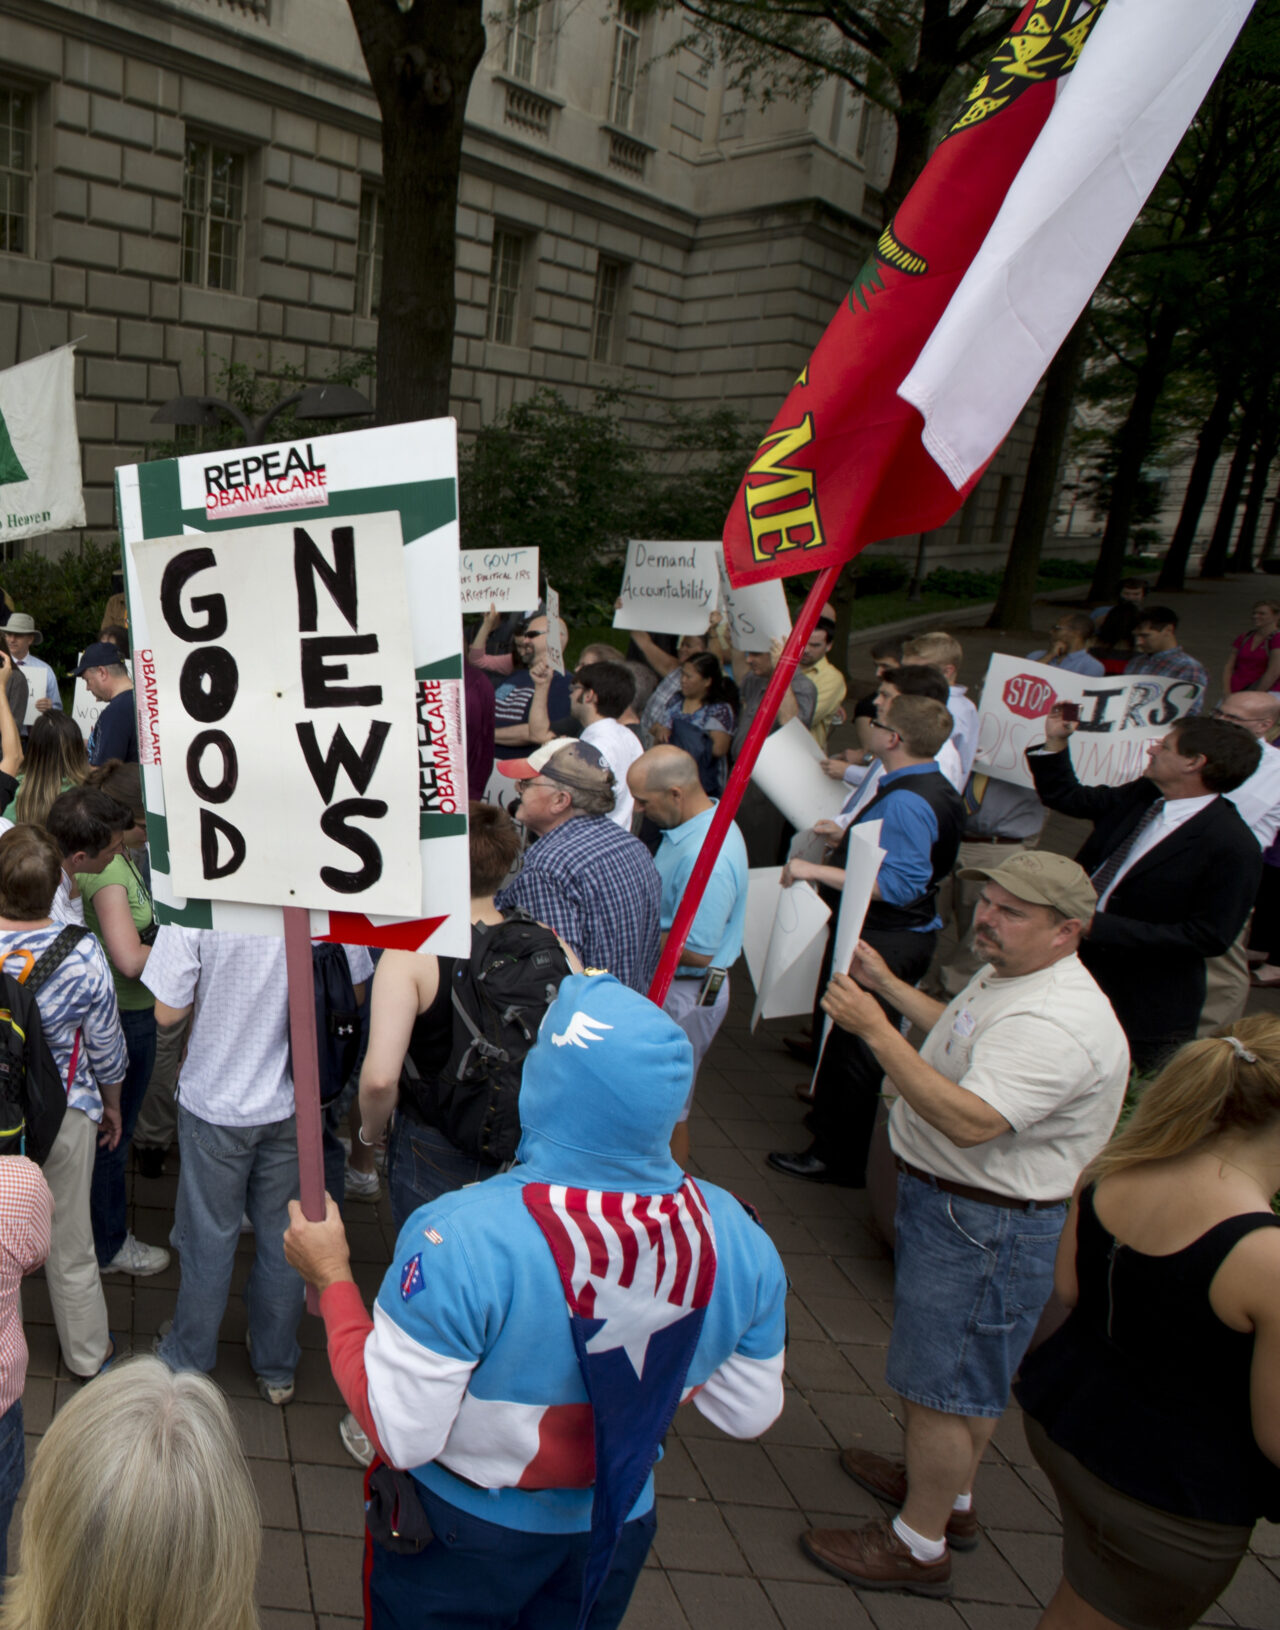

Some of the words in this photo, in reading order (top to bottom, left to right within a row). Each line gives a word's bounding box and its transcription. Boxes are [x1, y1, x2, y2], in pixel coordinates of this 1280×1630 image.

[204, 443, 326, 494] REPEAL
[205, 467, 328, 510] OBAMACARE
[744, 411, 829, 564] ME
[6, 511, 51, 529] Heaven
[483, 550, 528, 569] GOVT
[515, 569, 531, 581] IRS
[635, 543, 697, 568] Demand
[623, 574, 712, 607] Accountability
[141, 649, 162, 766] OBAMACARE
[160, 547, 246, 881] GOOD
[293, 526, 392, 894] NEWS
[1006, 676, 1053, 712] STOP
[1074, 681, 1200, 733] IRS
[423, 679, 456, 814] OBAMACARE
